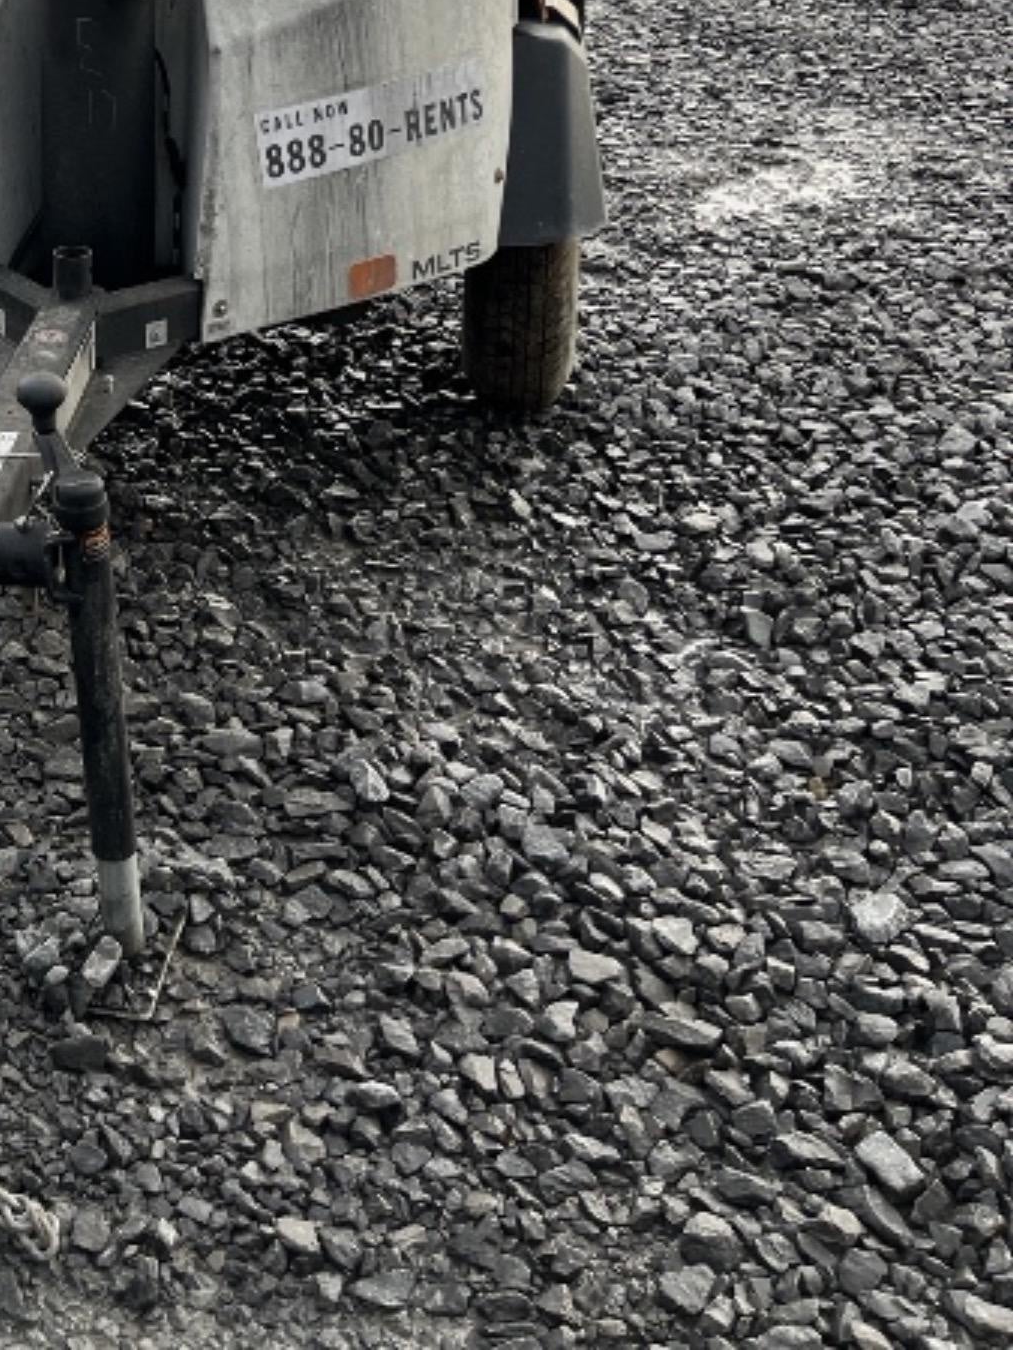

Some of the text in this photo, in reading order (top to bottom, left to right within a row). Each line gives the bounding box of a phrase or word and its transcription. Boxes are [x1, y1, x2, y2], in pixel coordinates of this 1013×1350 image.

[259, 110, 304, 135] CALL
[265, 88, 484, 179] 888-80-RENTS
[411, 240, 481, 281] MLTS
